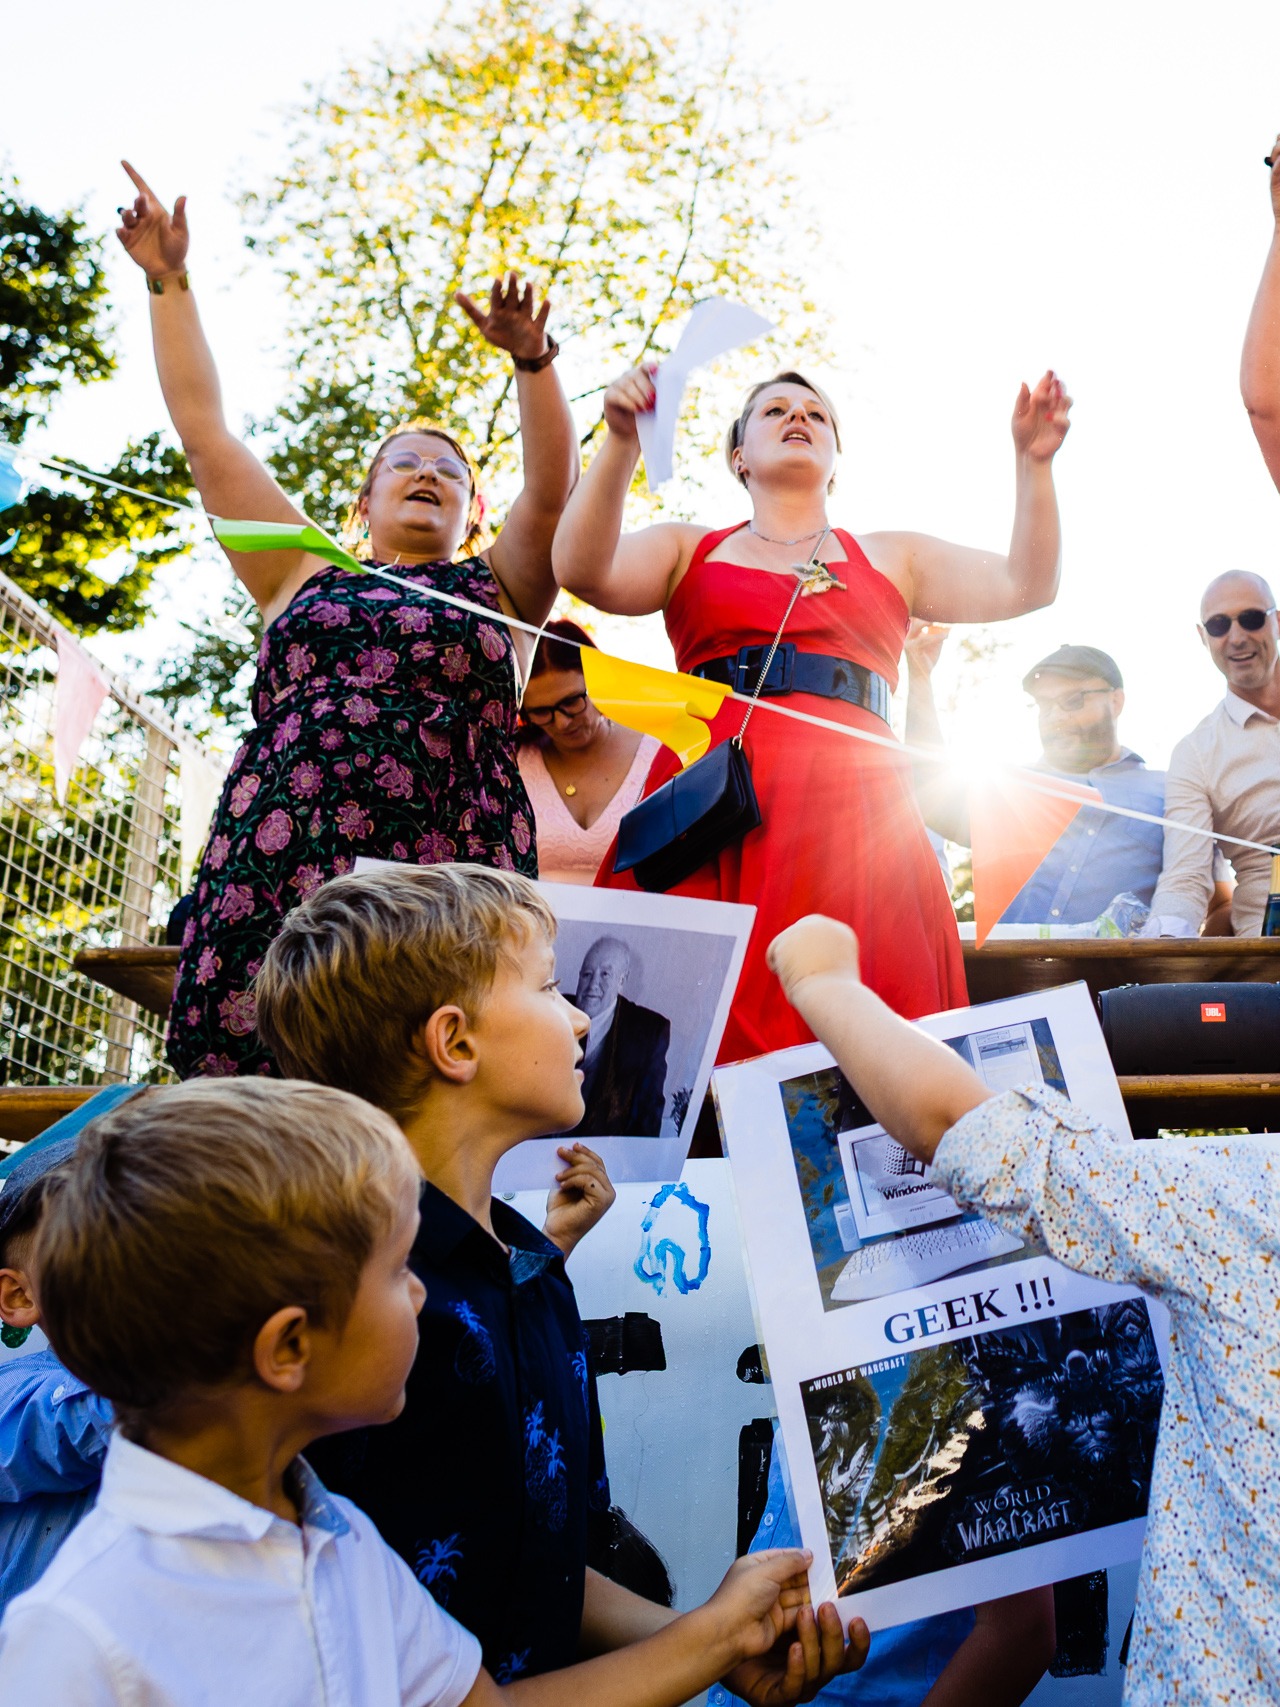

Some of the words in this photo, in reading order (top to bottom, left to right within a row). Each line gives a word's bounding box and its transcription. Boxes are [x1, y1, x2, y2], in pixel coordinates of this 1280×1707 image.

[1205, 1007, 1222, 1017] JBL
[882, 1182, 934, 1200] Windows
[884, 1288, 1007, 1345] GEEK
[1015, 1277, 1056, 1313] !!!
[845, 1369, 857, 1382] OF
[859, 1356, 906, 1377] WARCRAFT
[974, 1483, 1051, 1516] WORLD
